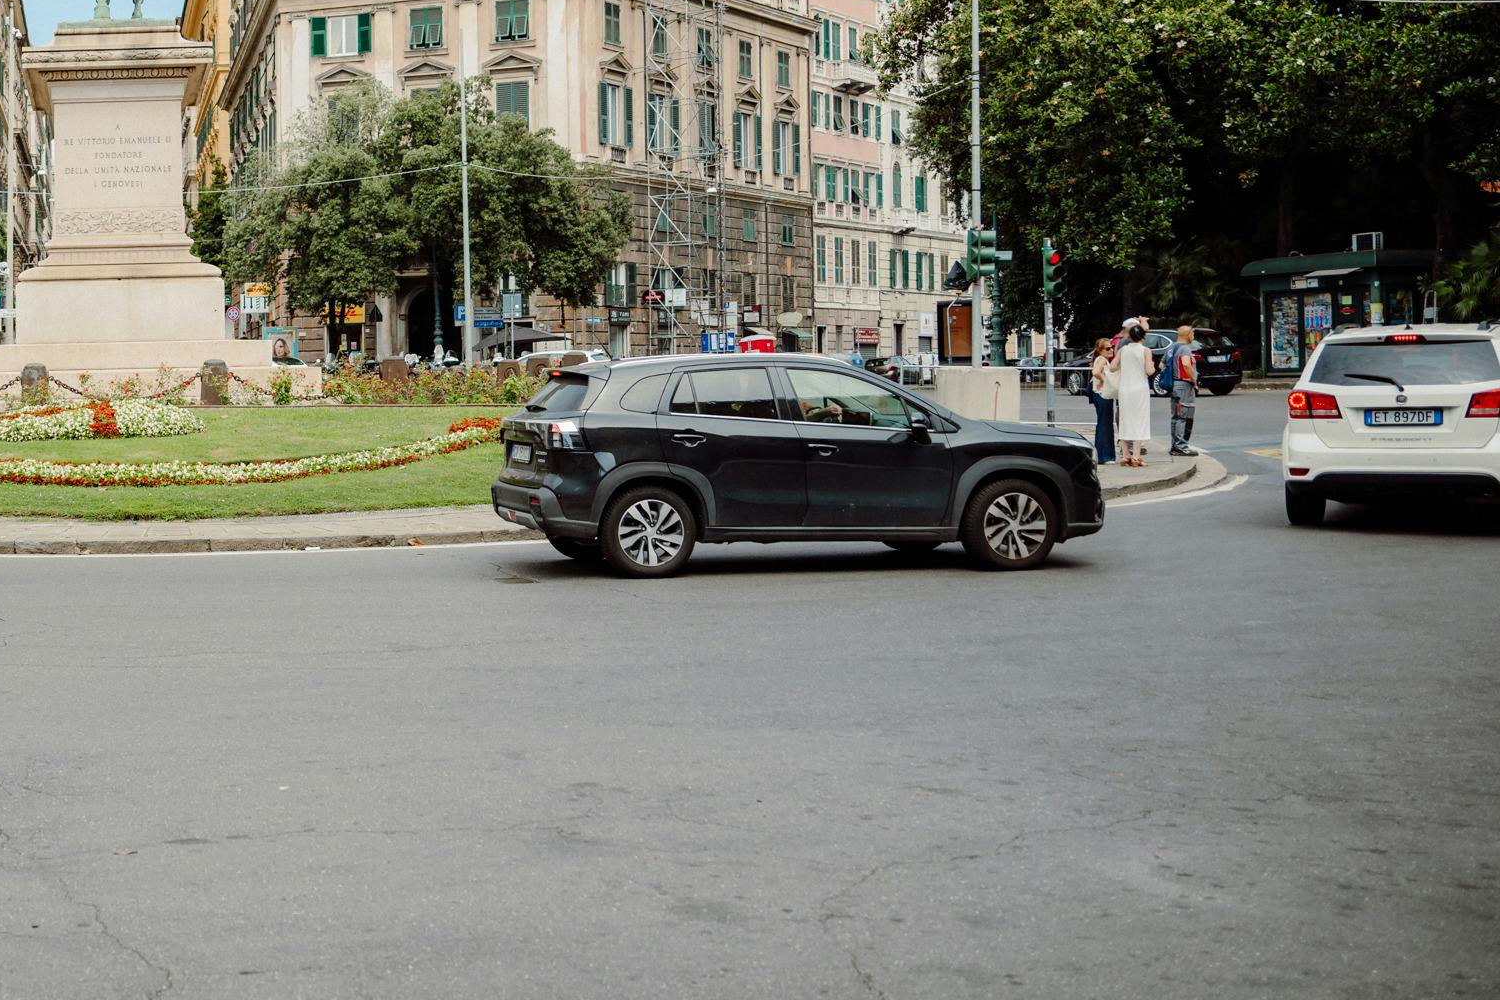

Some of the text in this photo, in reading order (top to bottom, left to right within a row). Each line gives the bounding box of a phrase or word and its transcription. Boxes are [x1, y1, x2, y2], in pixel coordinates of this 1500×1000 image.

[77, 137, 116, 146] VITTORIO
[119, 136, 161, 145] EMANUELE
[94, 151, 143, 159] FONDATORE
[64, 167, 89, 175] DELLA
[123, 165, 172, 173] NAZIONALE
[101, 180, 143, 188] GENOVESI
[1373, 411, 1433, 423] ET 897DF
